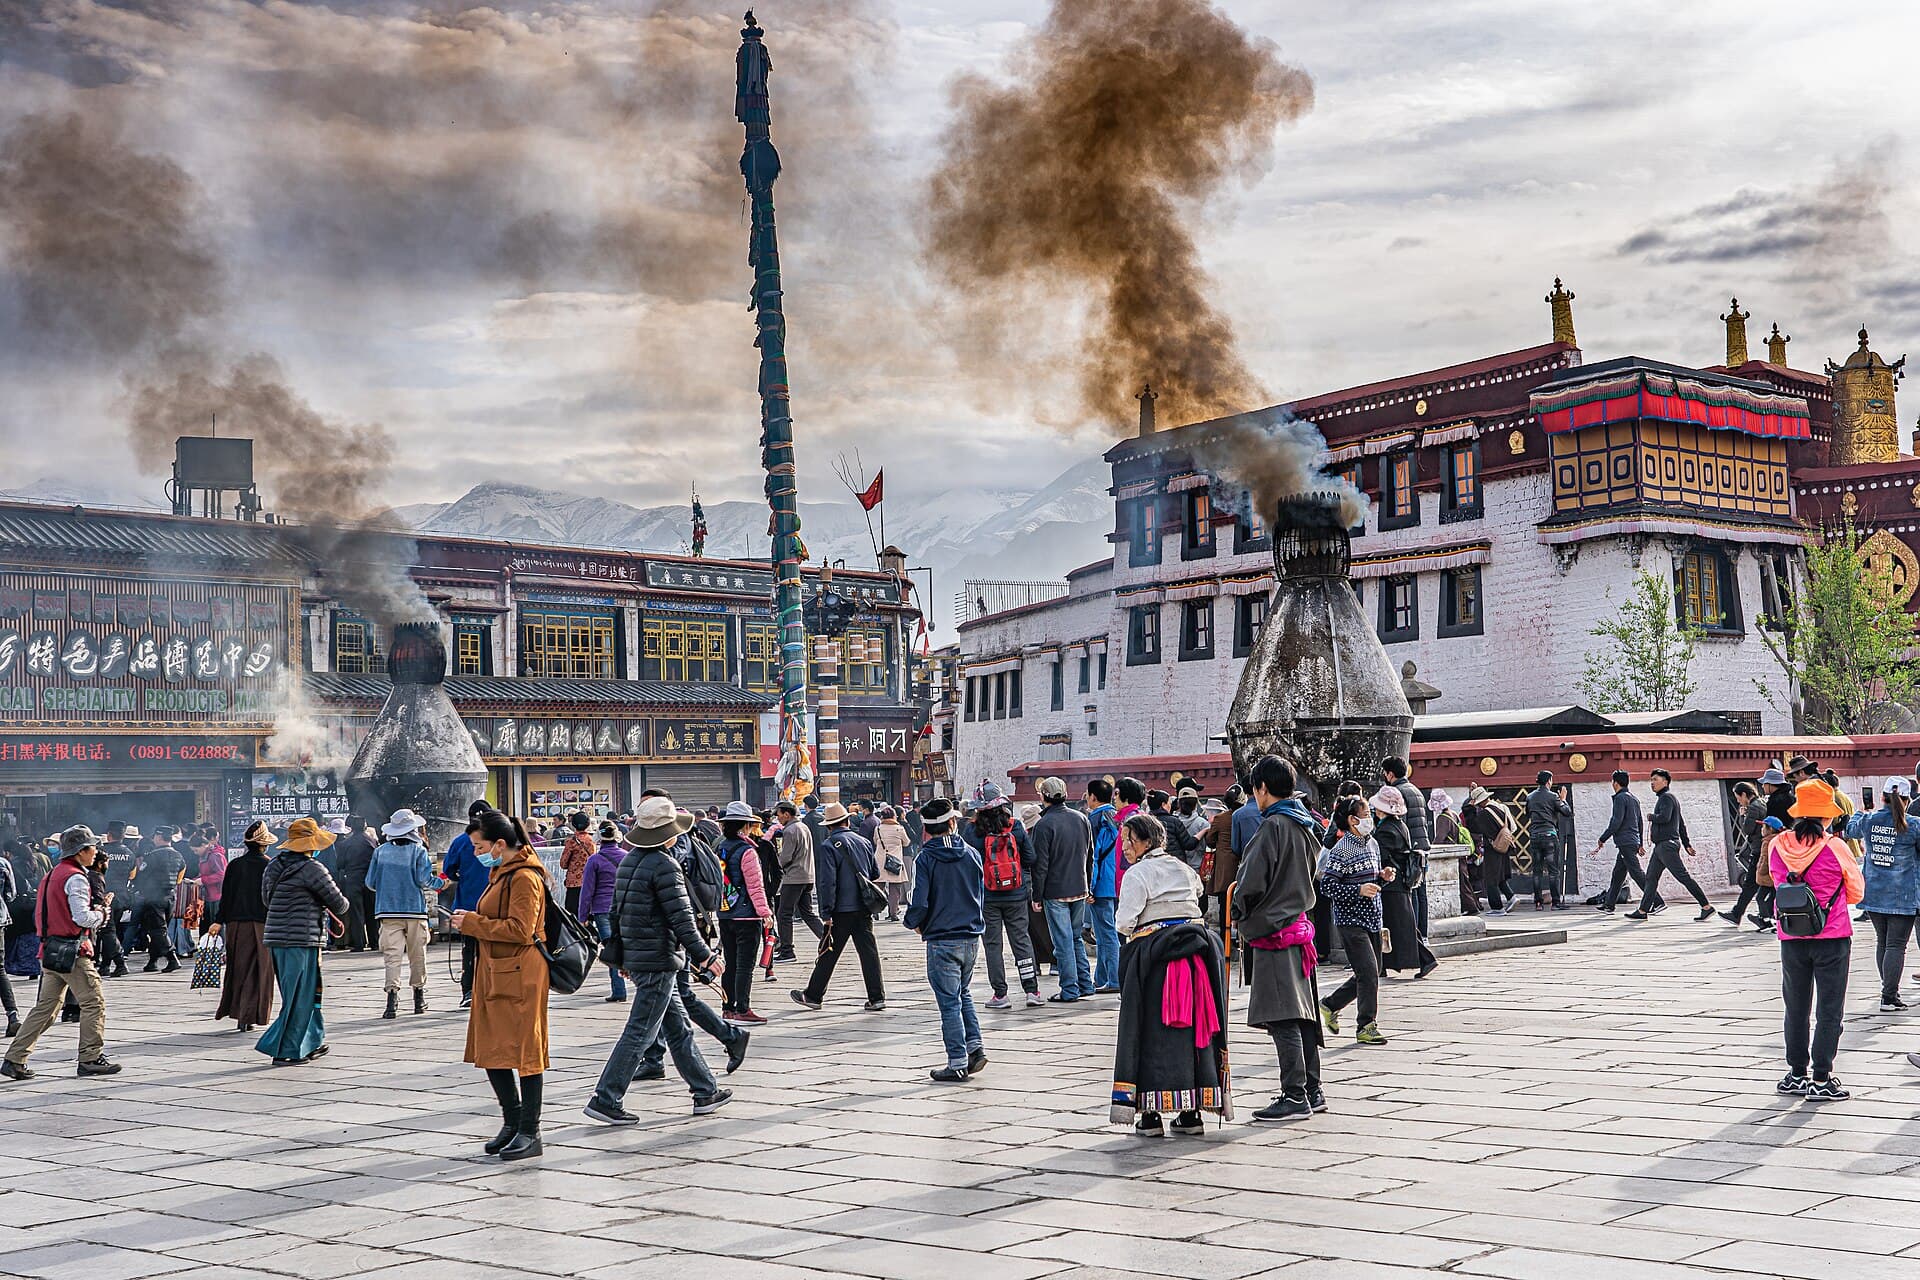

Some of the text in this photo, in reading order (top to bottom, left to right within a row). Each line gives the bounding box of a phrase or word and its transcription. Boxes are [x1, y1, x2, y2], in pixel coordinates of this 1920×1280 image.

[44, 687, 136, 711] SPECIALITY
[145, 689, 226, 712] PRODUCTS
[869, 726, 907, 753] 阿刁
